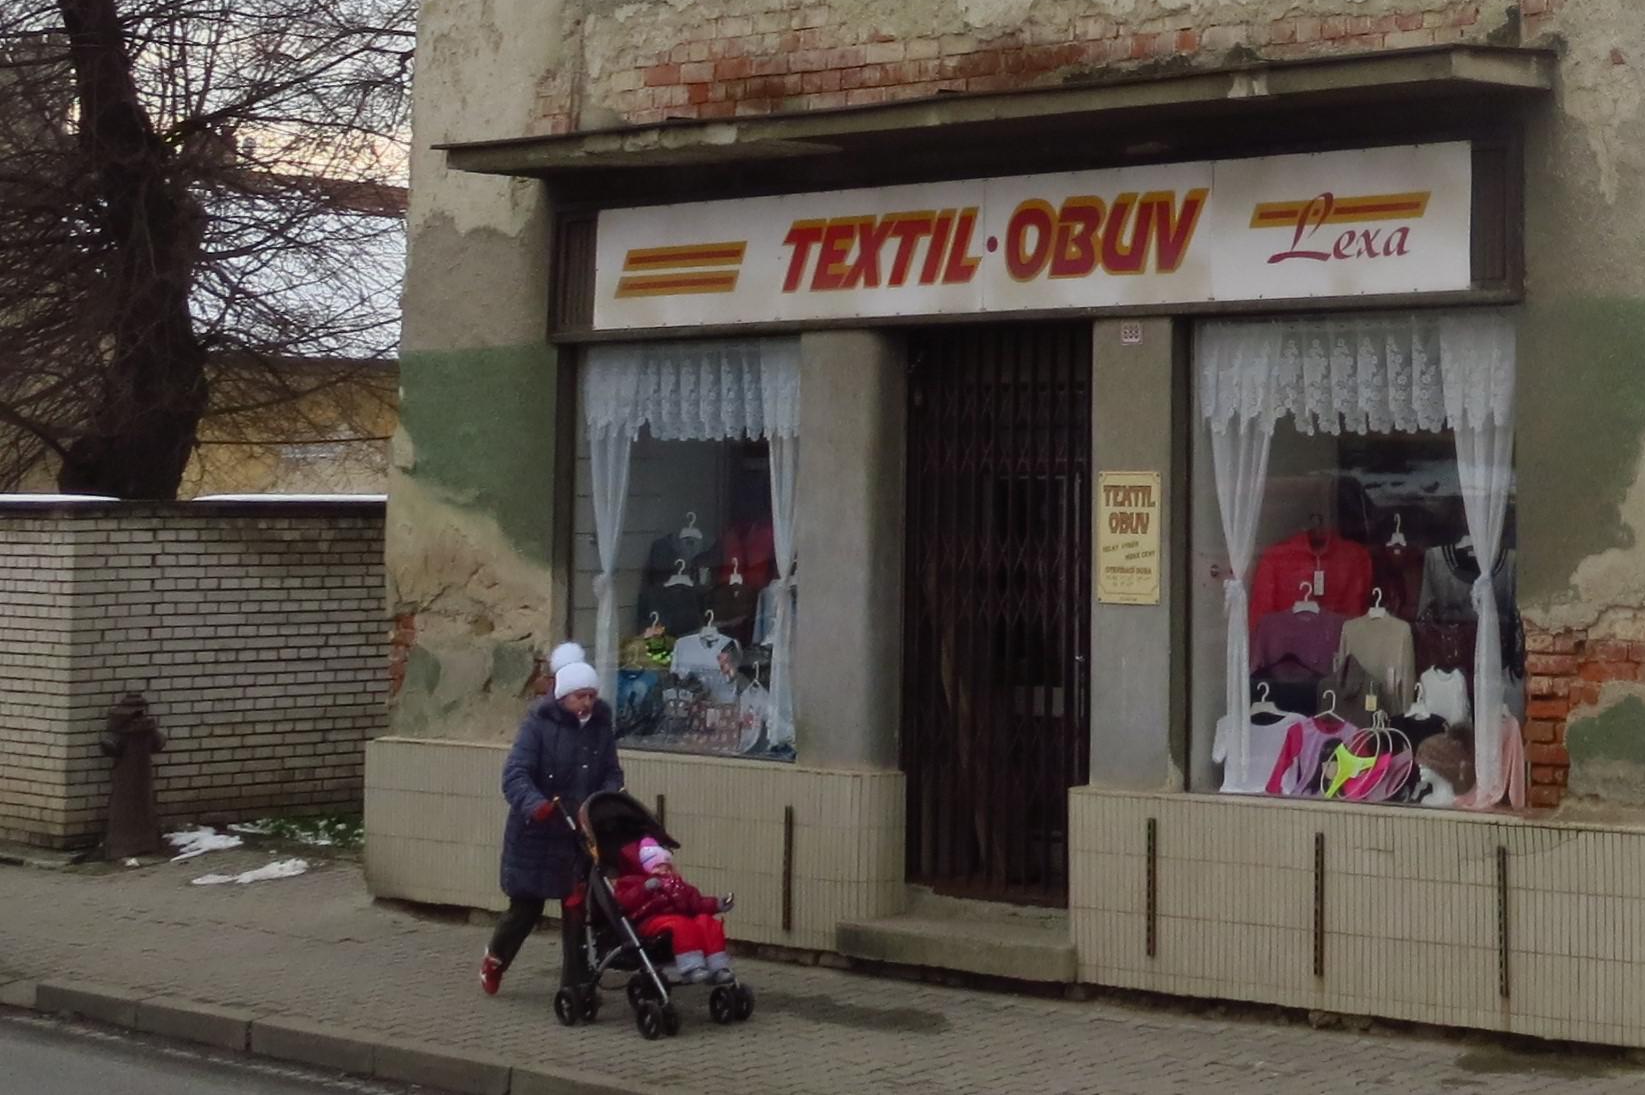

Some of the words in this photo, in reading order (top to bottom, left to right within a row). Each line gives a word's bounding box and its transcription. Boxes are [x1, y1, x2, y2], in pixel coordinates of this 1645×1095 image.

[782, 207, 982, 293] TEXTIL
[1005, 187, 1210, 283] OBUV
[1267, 191, 1411, 265] Lexa
[1104, 485, 1156, 507] TEXTIL
[1109, 512, 1149, 534] OBUV
